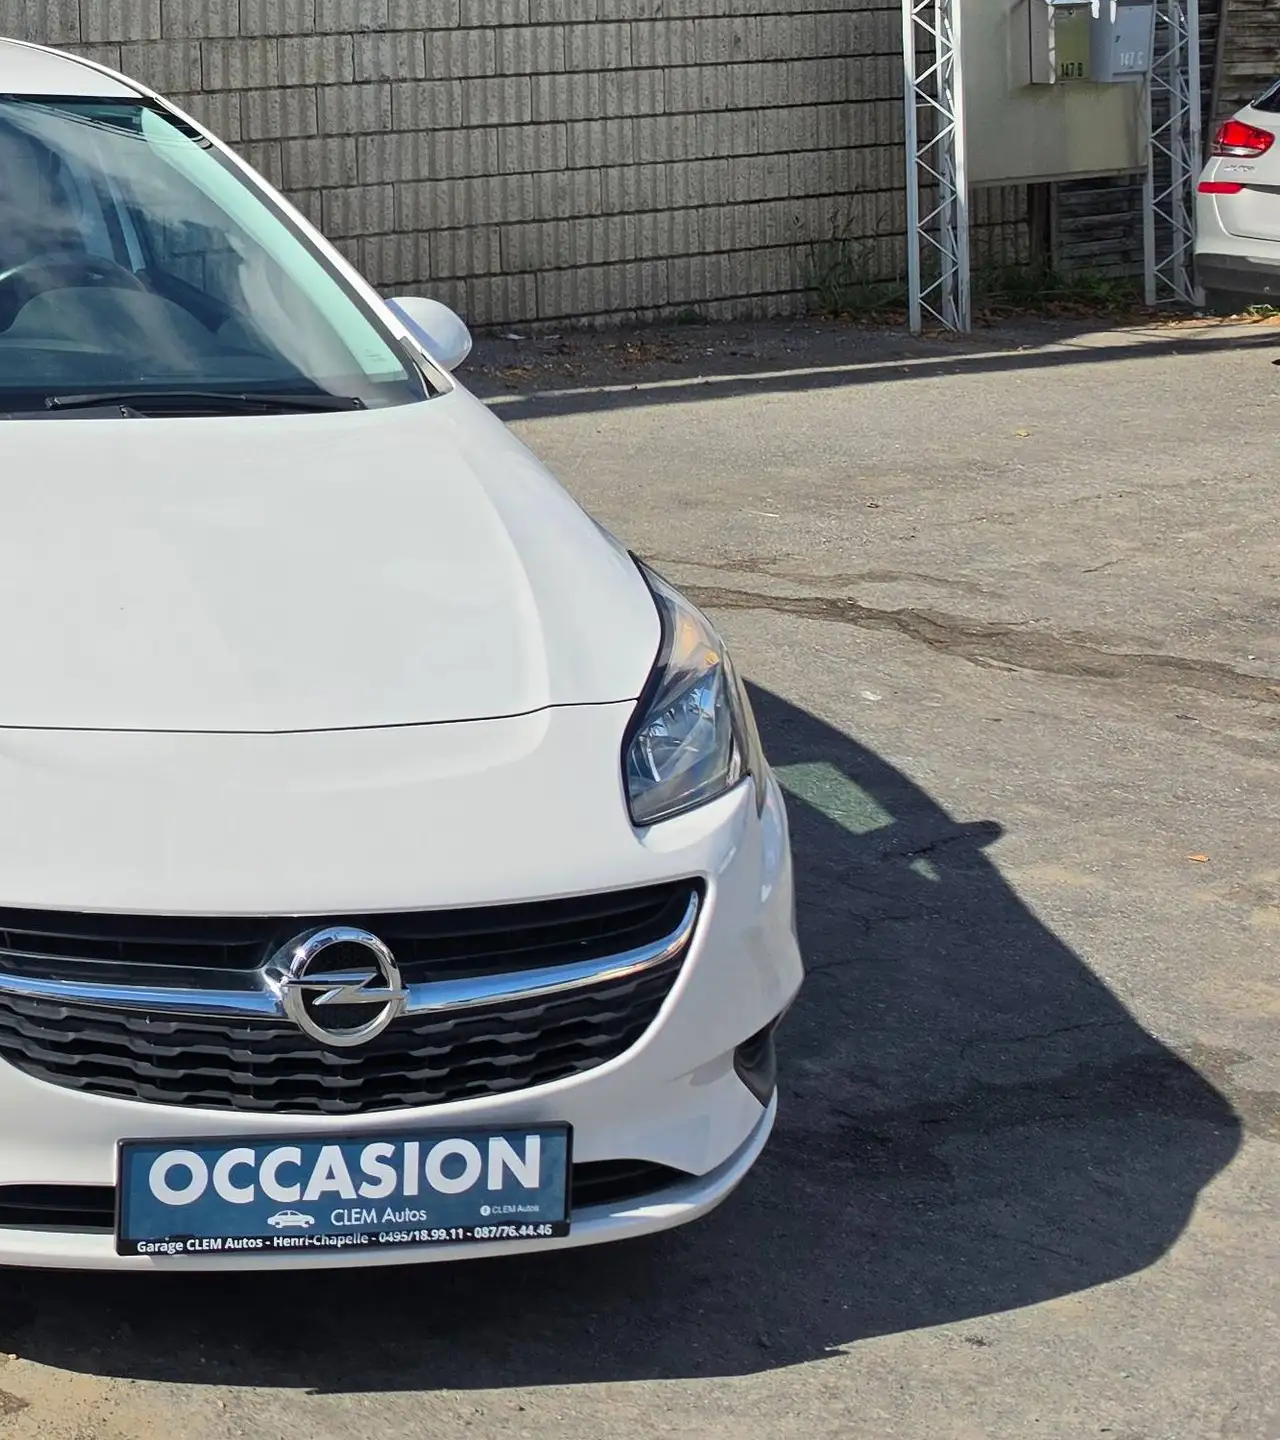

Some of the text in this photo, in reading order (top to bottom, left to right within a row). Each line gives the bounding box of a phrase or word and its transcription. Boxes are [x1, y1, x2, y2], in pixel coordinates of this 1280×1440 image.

[1120, 51, 1136, 67] 147
[1060, 62, 1075, 78] 147
[148, 1134, 541, 1206] OCCASION
[330, 1207, 427, 1226] CLEM Autos
[491, 1206, 516, 1215] CLEM
[137, 1240, 183, 1255] Garage
[186, 1238, 222, 1251] CLEM
[224, 1237, 263, 1249] Autos
[273, 1232, 369, 1248] Henri-Chapelle
[378, 1228, 464, 1244] 0495/18.99.11
